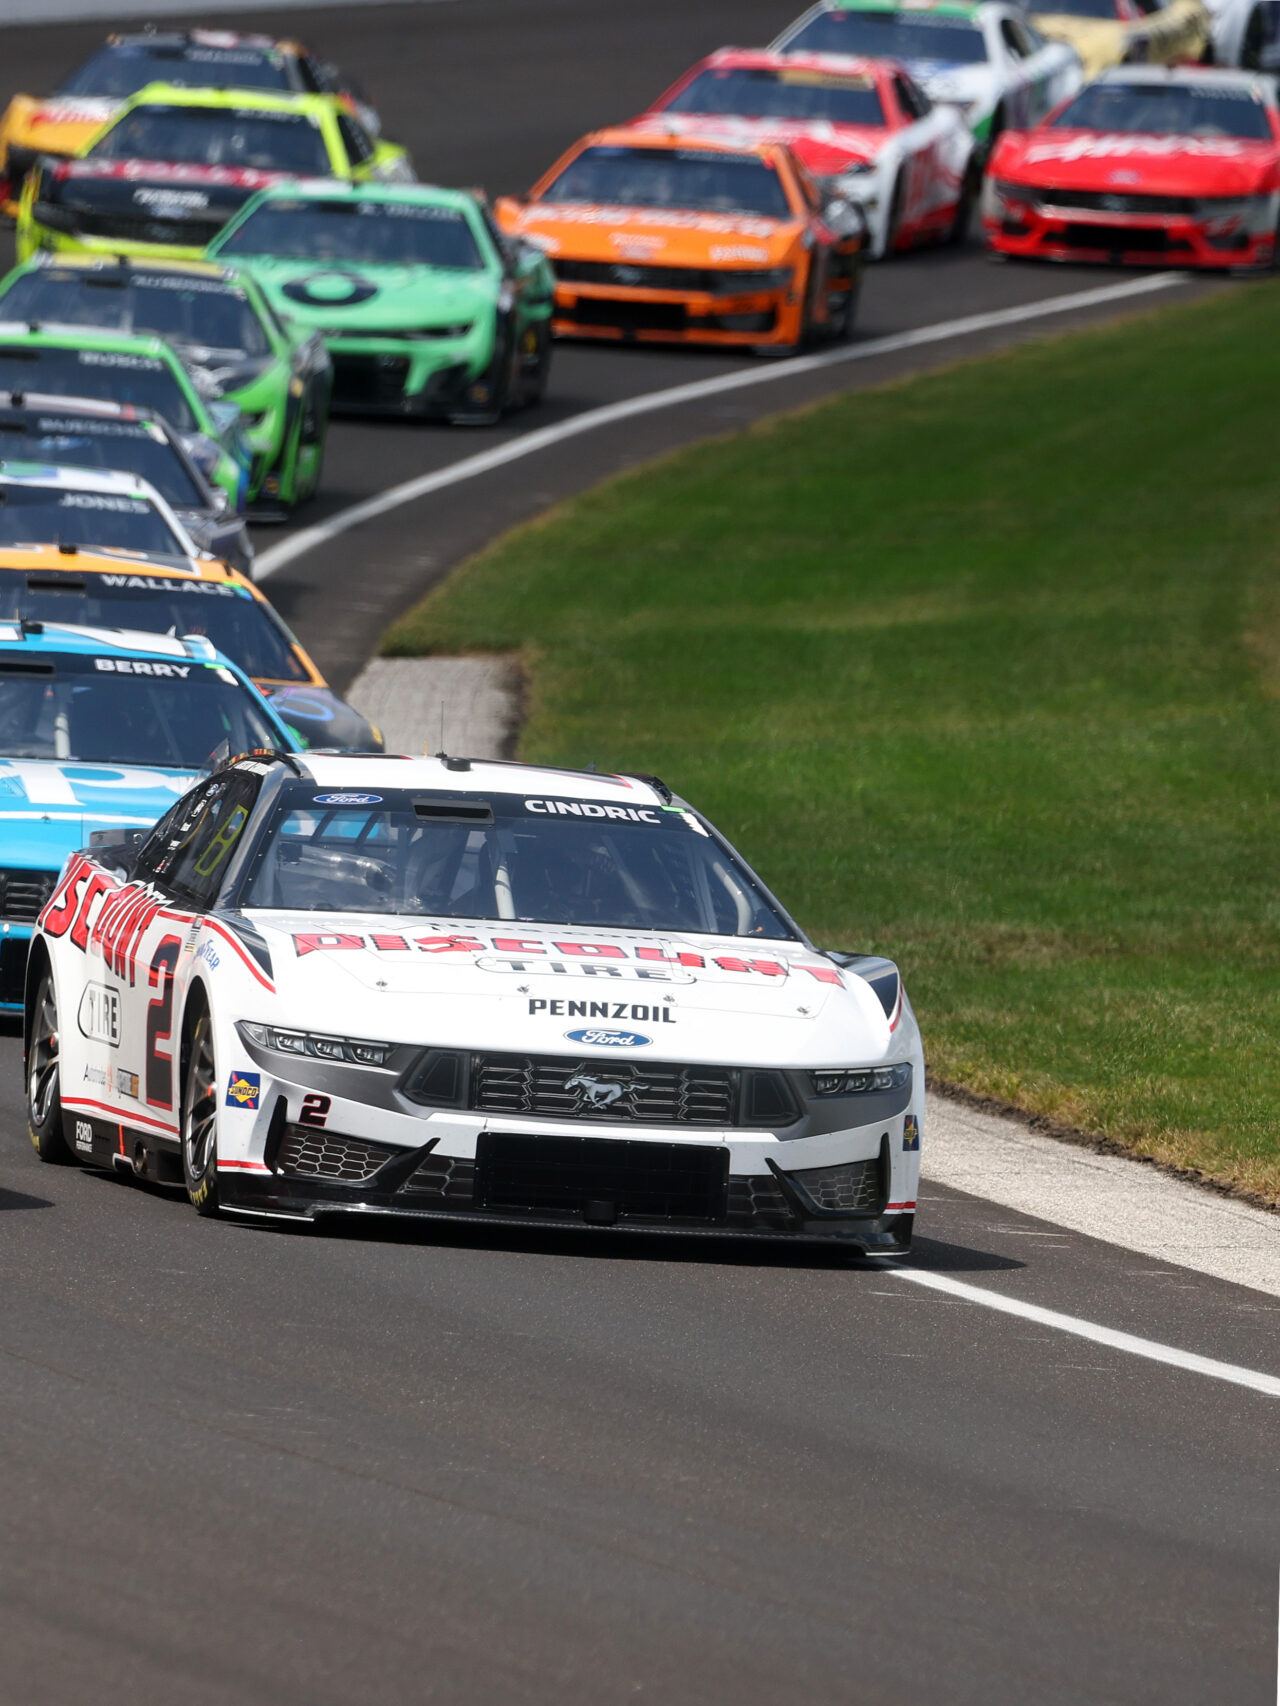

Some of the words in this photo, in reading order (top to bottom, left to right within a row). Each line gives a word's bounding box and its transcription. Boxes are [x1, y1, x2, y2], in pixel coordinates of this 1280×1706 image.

[100, 573, 235, 597] WALLACE
[94, 657, 191, 680] BERRY
[523, 799, 662, 825] CINDRIC
[290, 931, 846, 990] DISCOUNT
[494, 958, 674, 982] TIRE
[88, 988, 118, 1040] TIRE
[527, 998, 677, 1024] PENNZOIL
[228, 1086, 260, 1097] SUNOCO
[297, 1094, 332, 1127] 2
[75, 1121, 93, 1143] FORD
